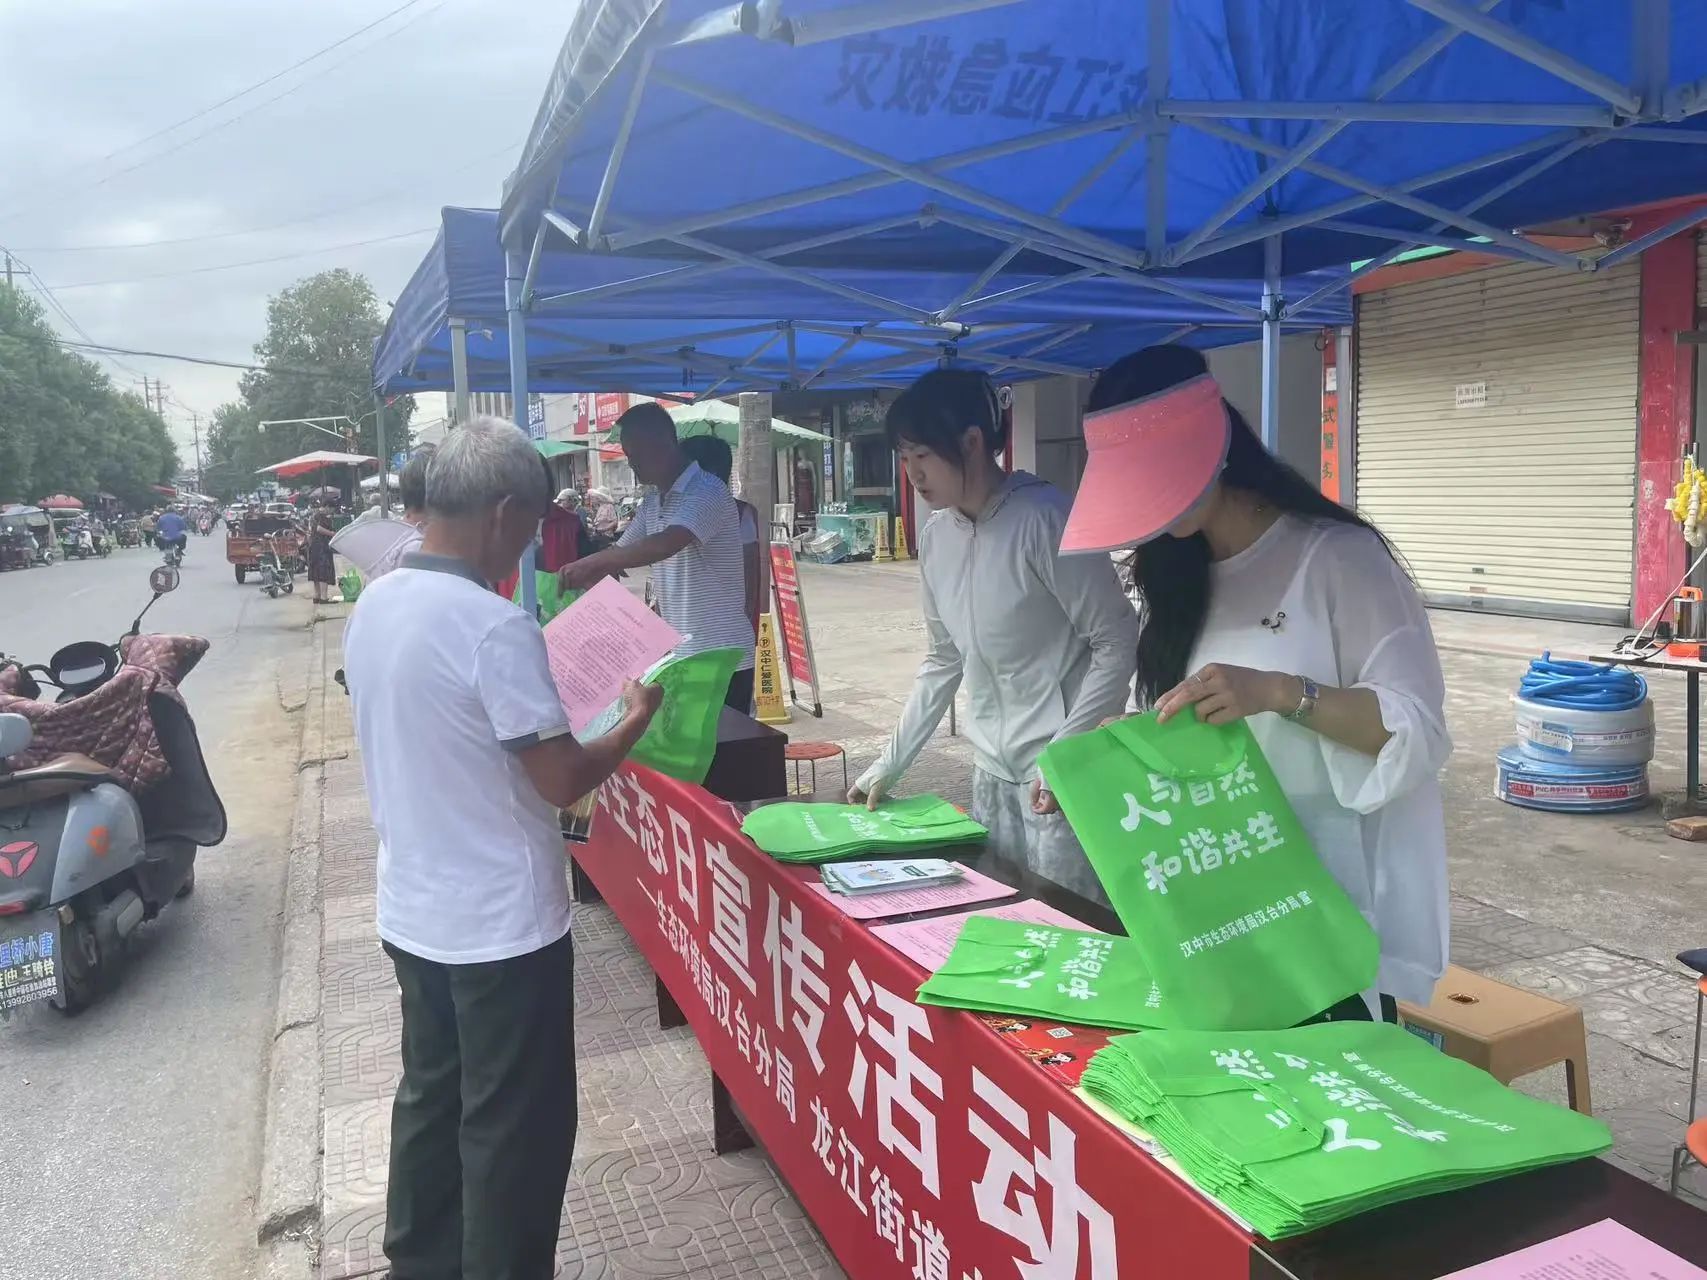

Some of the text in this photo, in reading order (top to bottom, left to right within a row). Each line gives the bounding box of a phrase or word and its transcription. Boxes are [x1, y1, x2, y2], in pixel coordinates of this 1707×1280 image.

[1141, 811, 1285, 895] 和谐共生
[809, 1096, 983, 1280] 龙江街道
